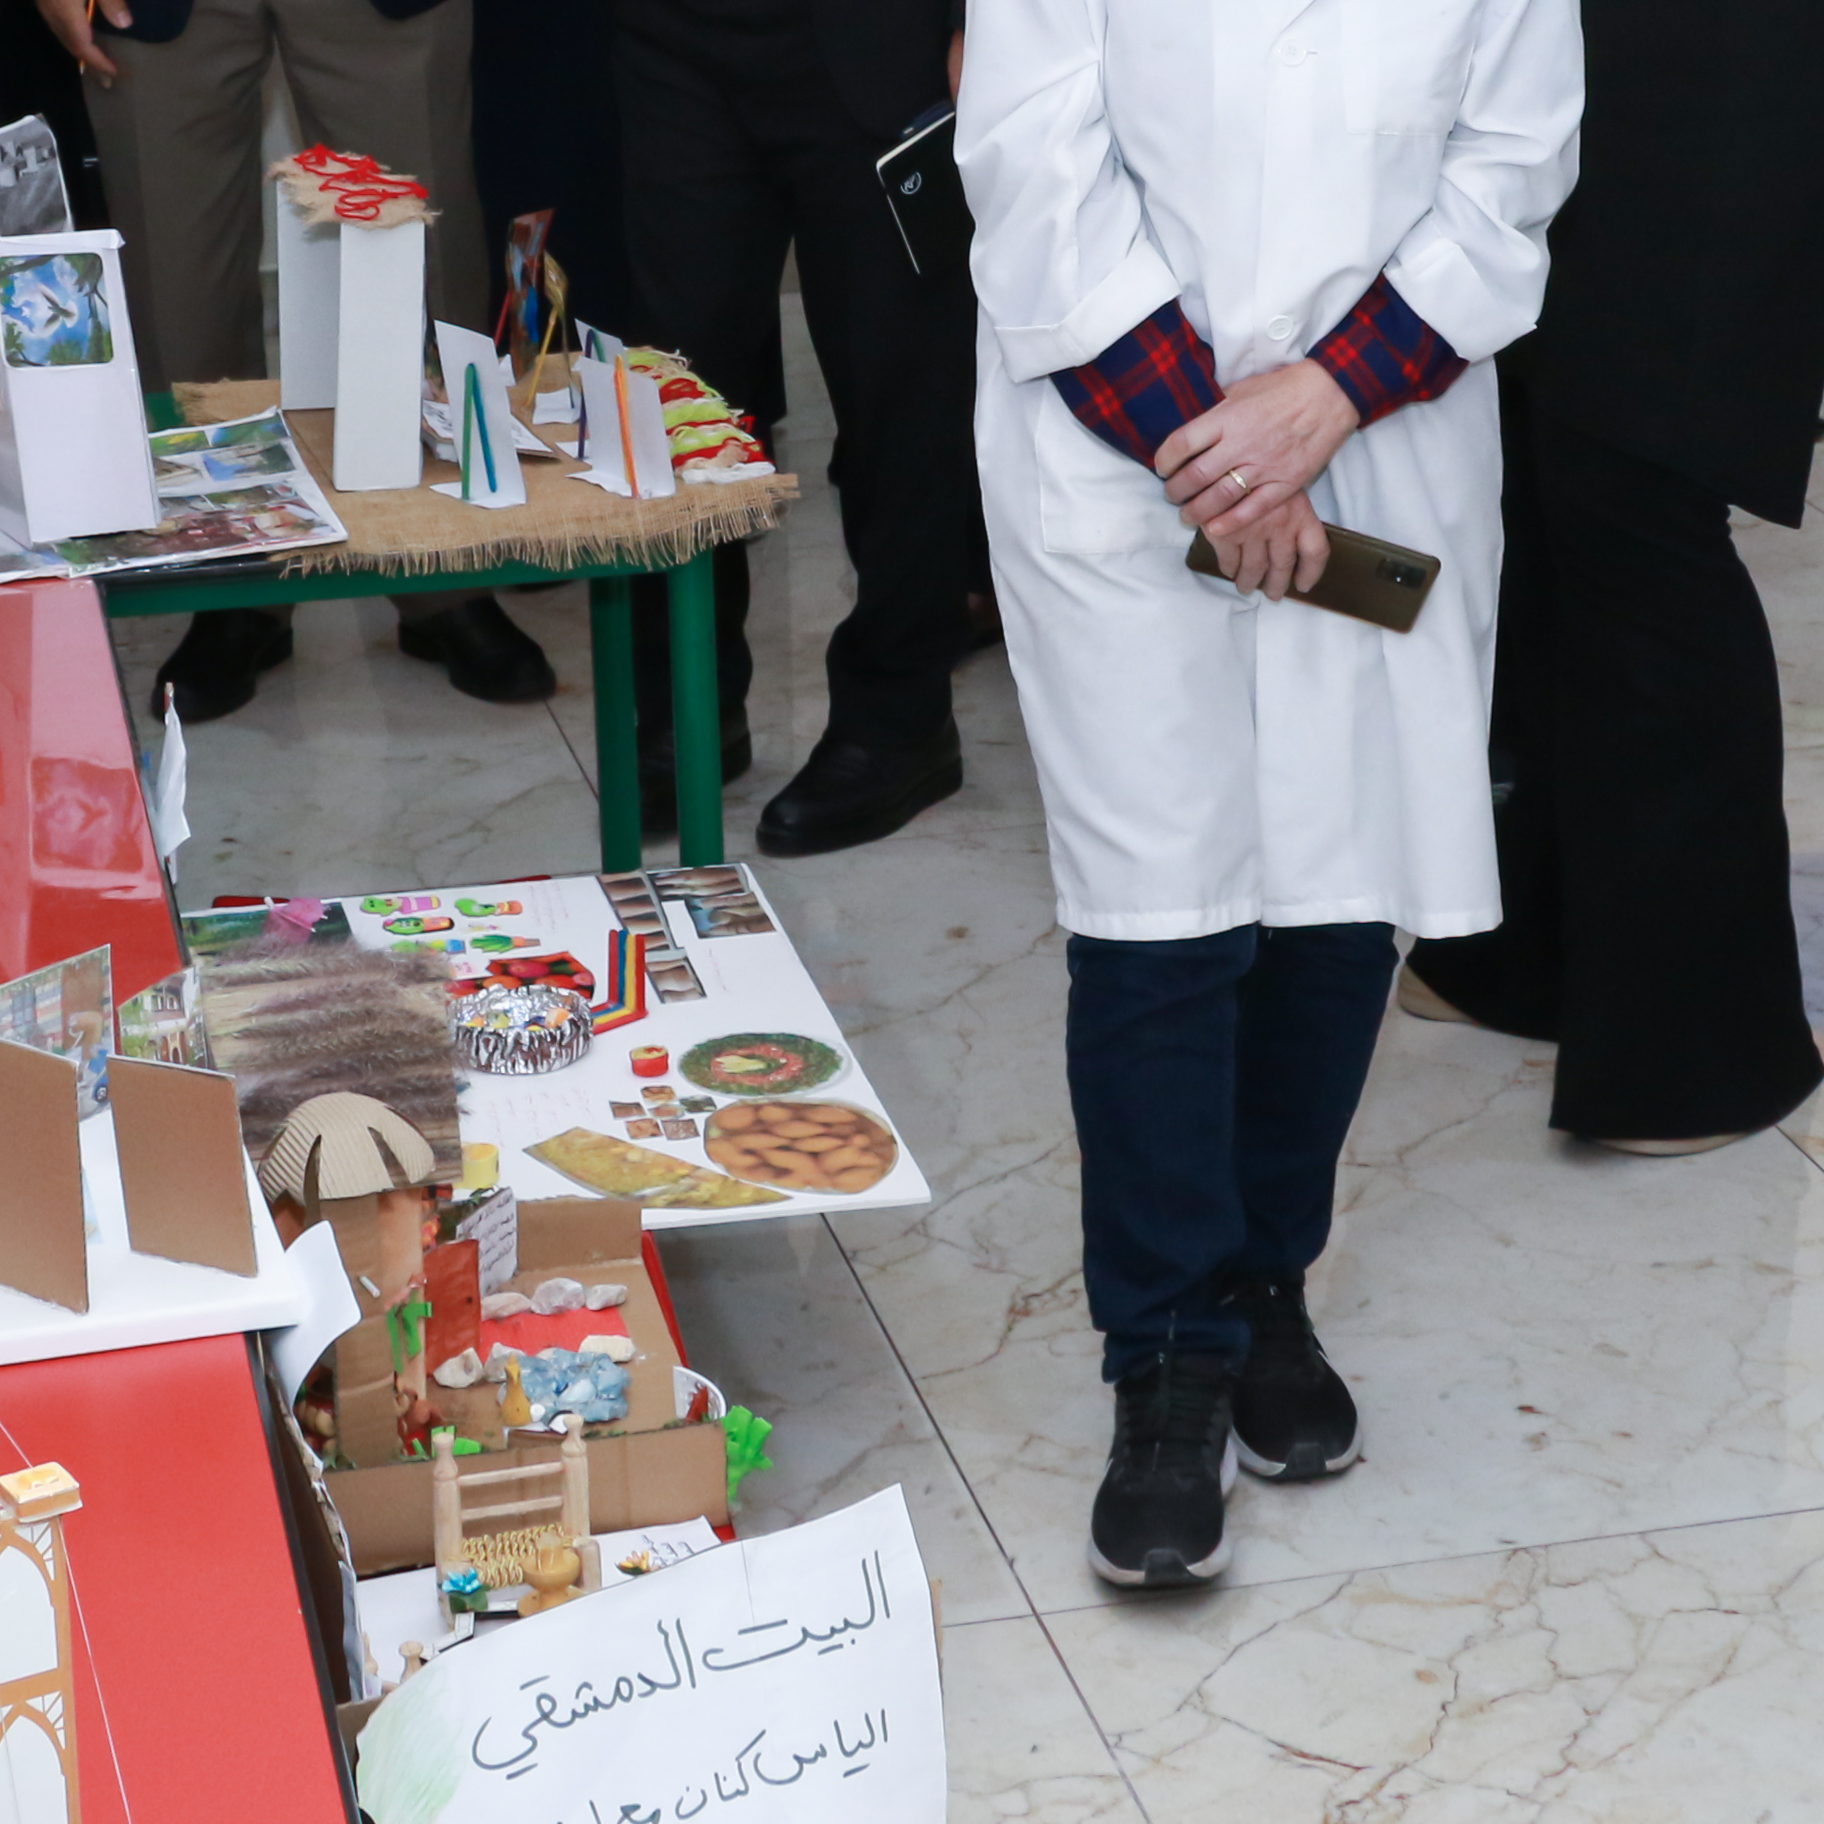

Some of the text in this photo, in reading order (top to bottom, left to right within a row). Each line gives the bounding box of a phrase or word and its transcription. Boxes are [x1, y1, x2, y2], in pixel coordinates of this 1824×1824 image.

[471, 1549, 892, 1780] البيت الدمشقي
[753, 1708, 889, 1786] الياس
